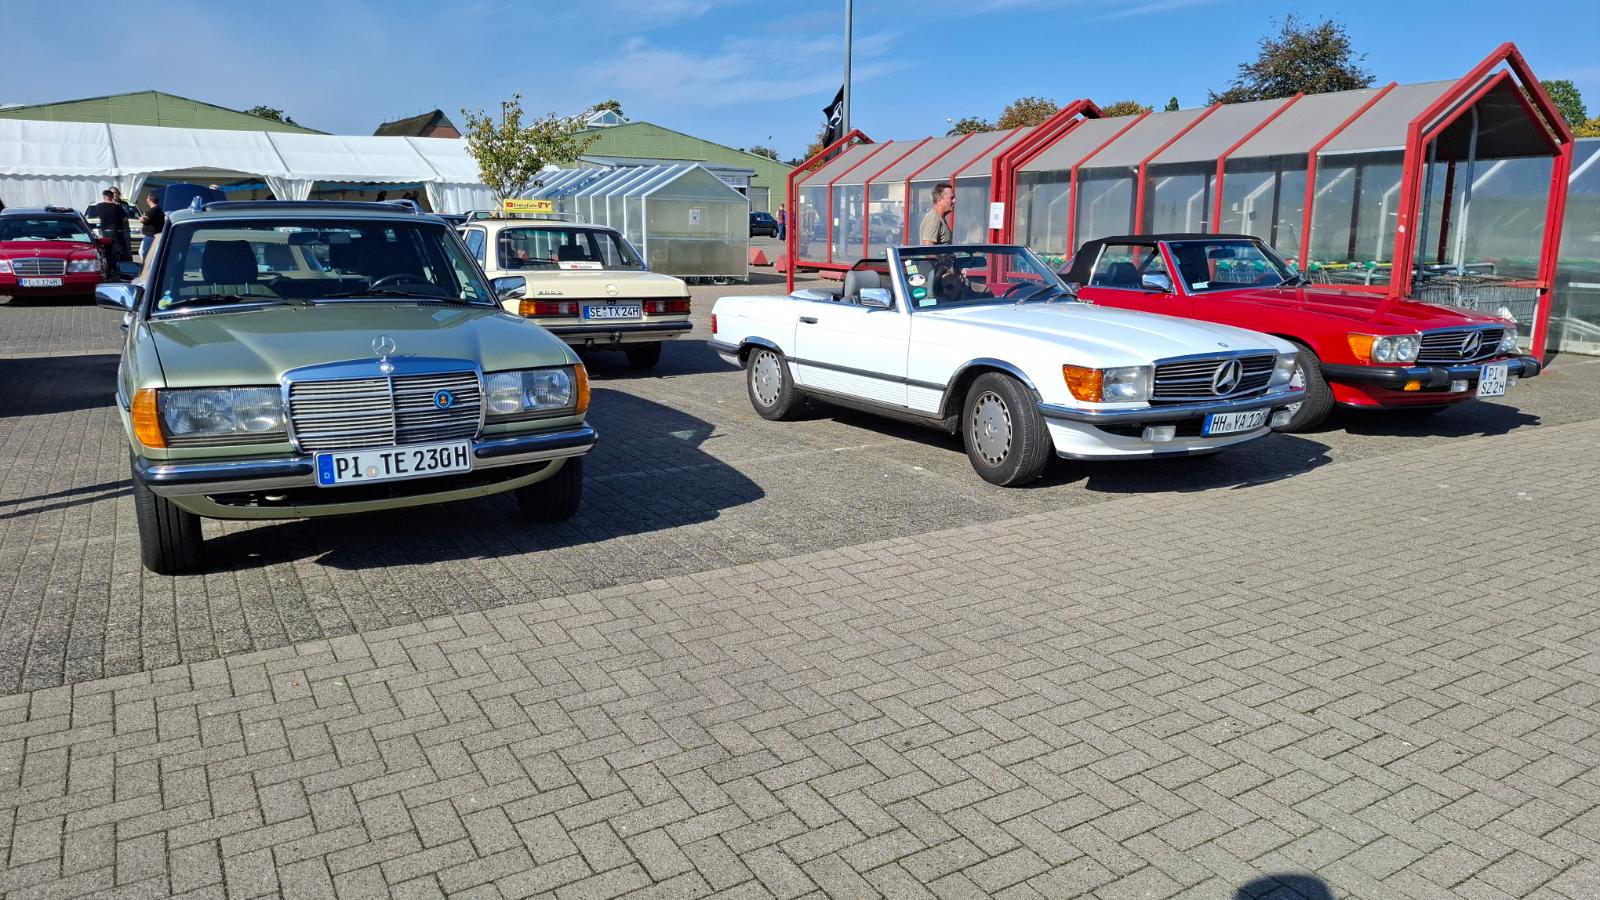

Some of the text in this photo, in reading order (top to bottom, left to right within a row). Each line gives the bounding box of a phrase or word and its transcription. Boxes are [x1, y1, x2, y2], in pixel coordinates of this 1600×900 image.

[590, 307, 639, 317] SE TX 24H
[1489, 367, 1498, 380] PI
[1211, 415, 1227, 431] HH
[1234, 414, 1246, 429] YA
[335, 445, 468, 479] PI TE 230H
